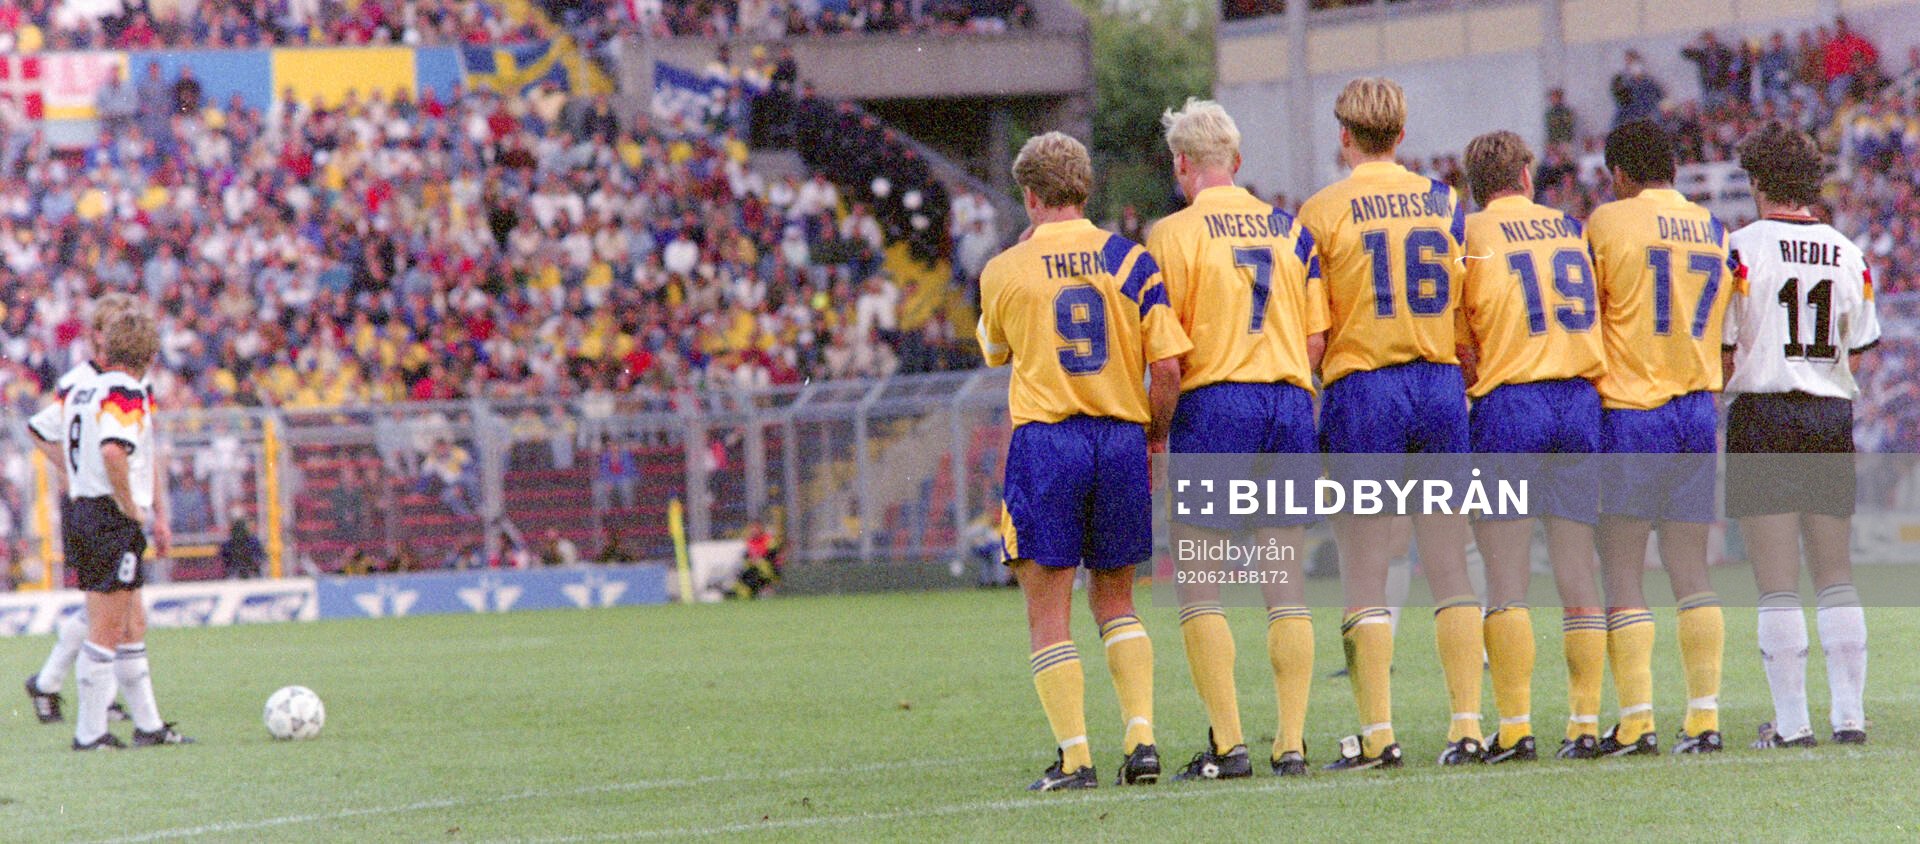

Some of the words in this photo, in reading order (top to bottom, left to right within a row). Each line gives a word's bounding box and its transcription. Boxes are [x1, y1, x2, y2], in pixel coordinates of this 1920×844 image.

[1041, 250, 1107, 279] THERN
[1231, 245, 1275, 334] 7
[1361, 227, 1452, 319] 16
[1505, 247, 1599, 336] 19
[1646, 246, 1723, 341] 17
[1779, 240, 1842, 267] RIEDLE
[1052, 283, 1110, 377] 9
[1778, 277, 1841, 363] 11
[117, 552, 138, 583] 8
